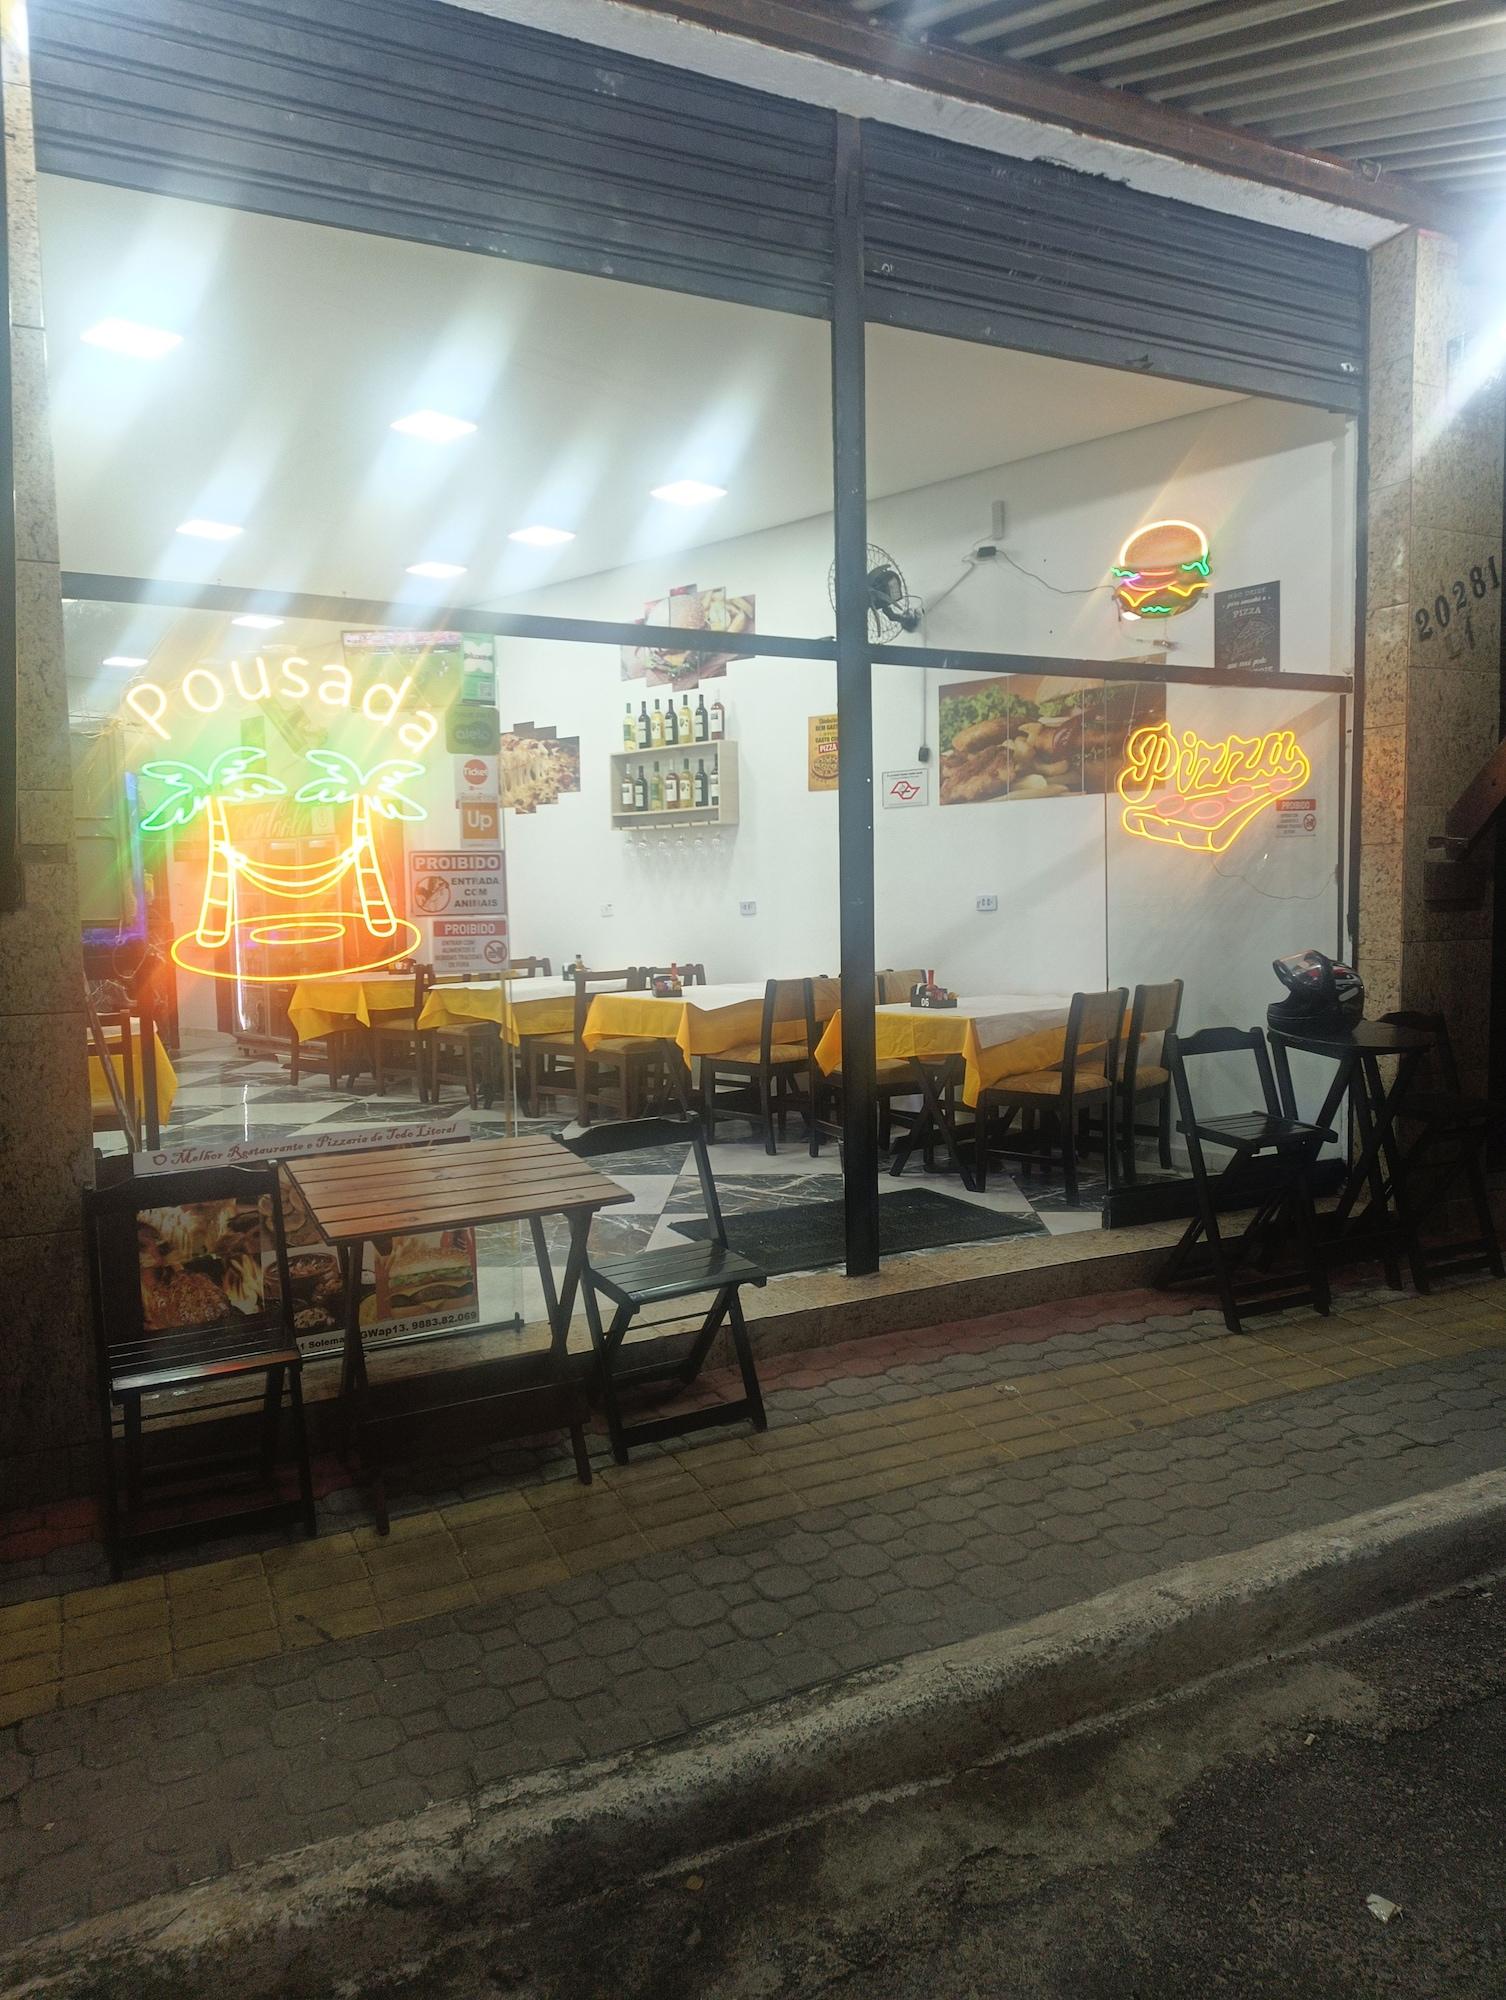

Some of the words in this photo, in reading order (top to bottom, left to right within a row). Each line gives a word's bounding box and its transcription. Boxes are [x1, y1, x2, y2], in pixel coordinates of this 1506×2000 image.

[1415, 555, 1499, 641] 20281
[126, 656, 438, 753] Pousada
[819, 743, 837, 753] PIZZA
[1117, 722, 1310, 804] Pizza
[464, 767, 488, 777] Ticket
[466, 811, 493, 831] Up
[415, 856, 499, 870] PROIBIDO
[451, 877, 500, 885] ENTRADA
[464, 888, 488, 896] COM
[454, 899, 498, 908] ANIMAIS
[444, 923, 496, 935] PROIBIDO
[152, 1153, 168, 1166] O
[171, 1147, 223, 1165] Melhor
[227, 1143, 304, 1161] Restaurante
[316, 1133, 367, 1149] Pizzaria
[385, 1126, 414, 1140] Todo
[415, 1123, 457, 1138] Litoral
[309, 1335, 346, 1350] Solema
